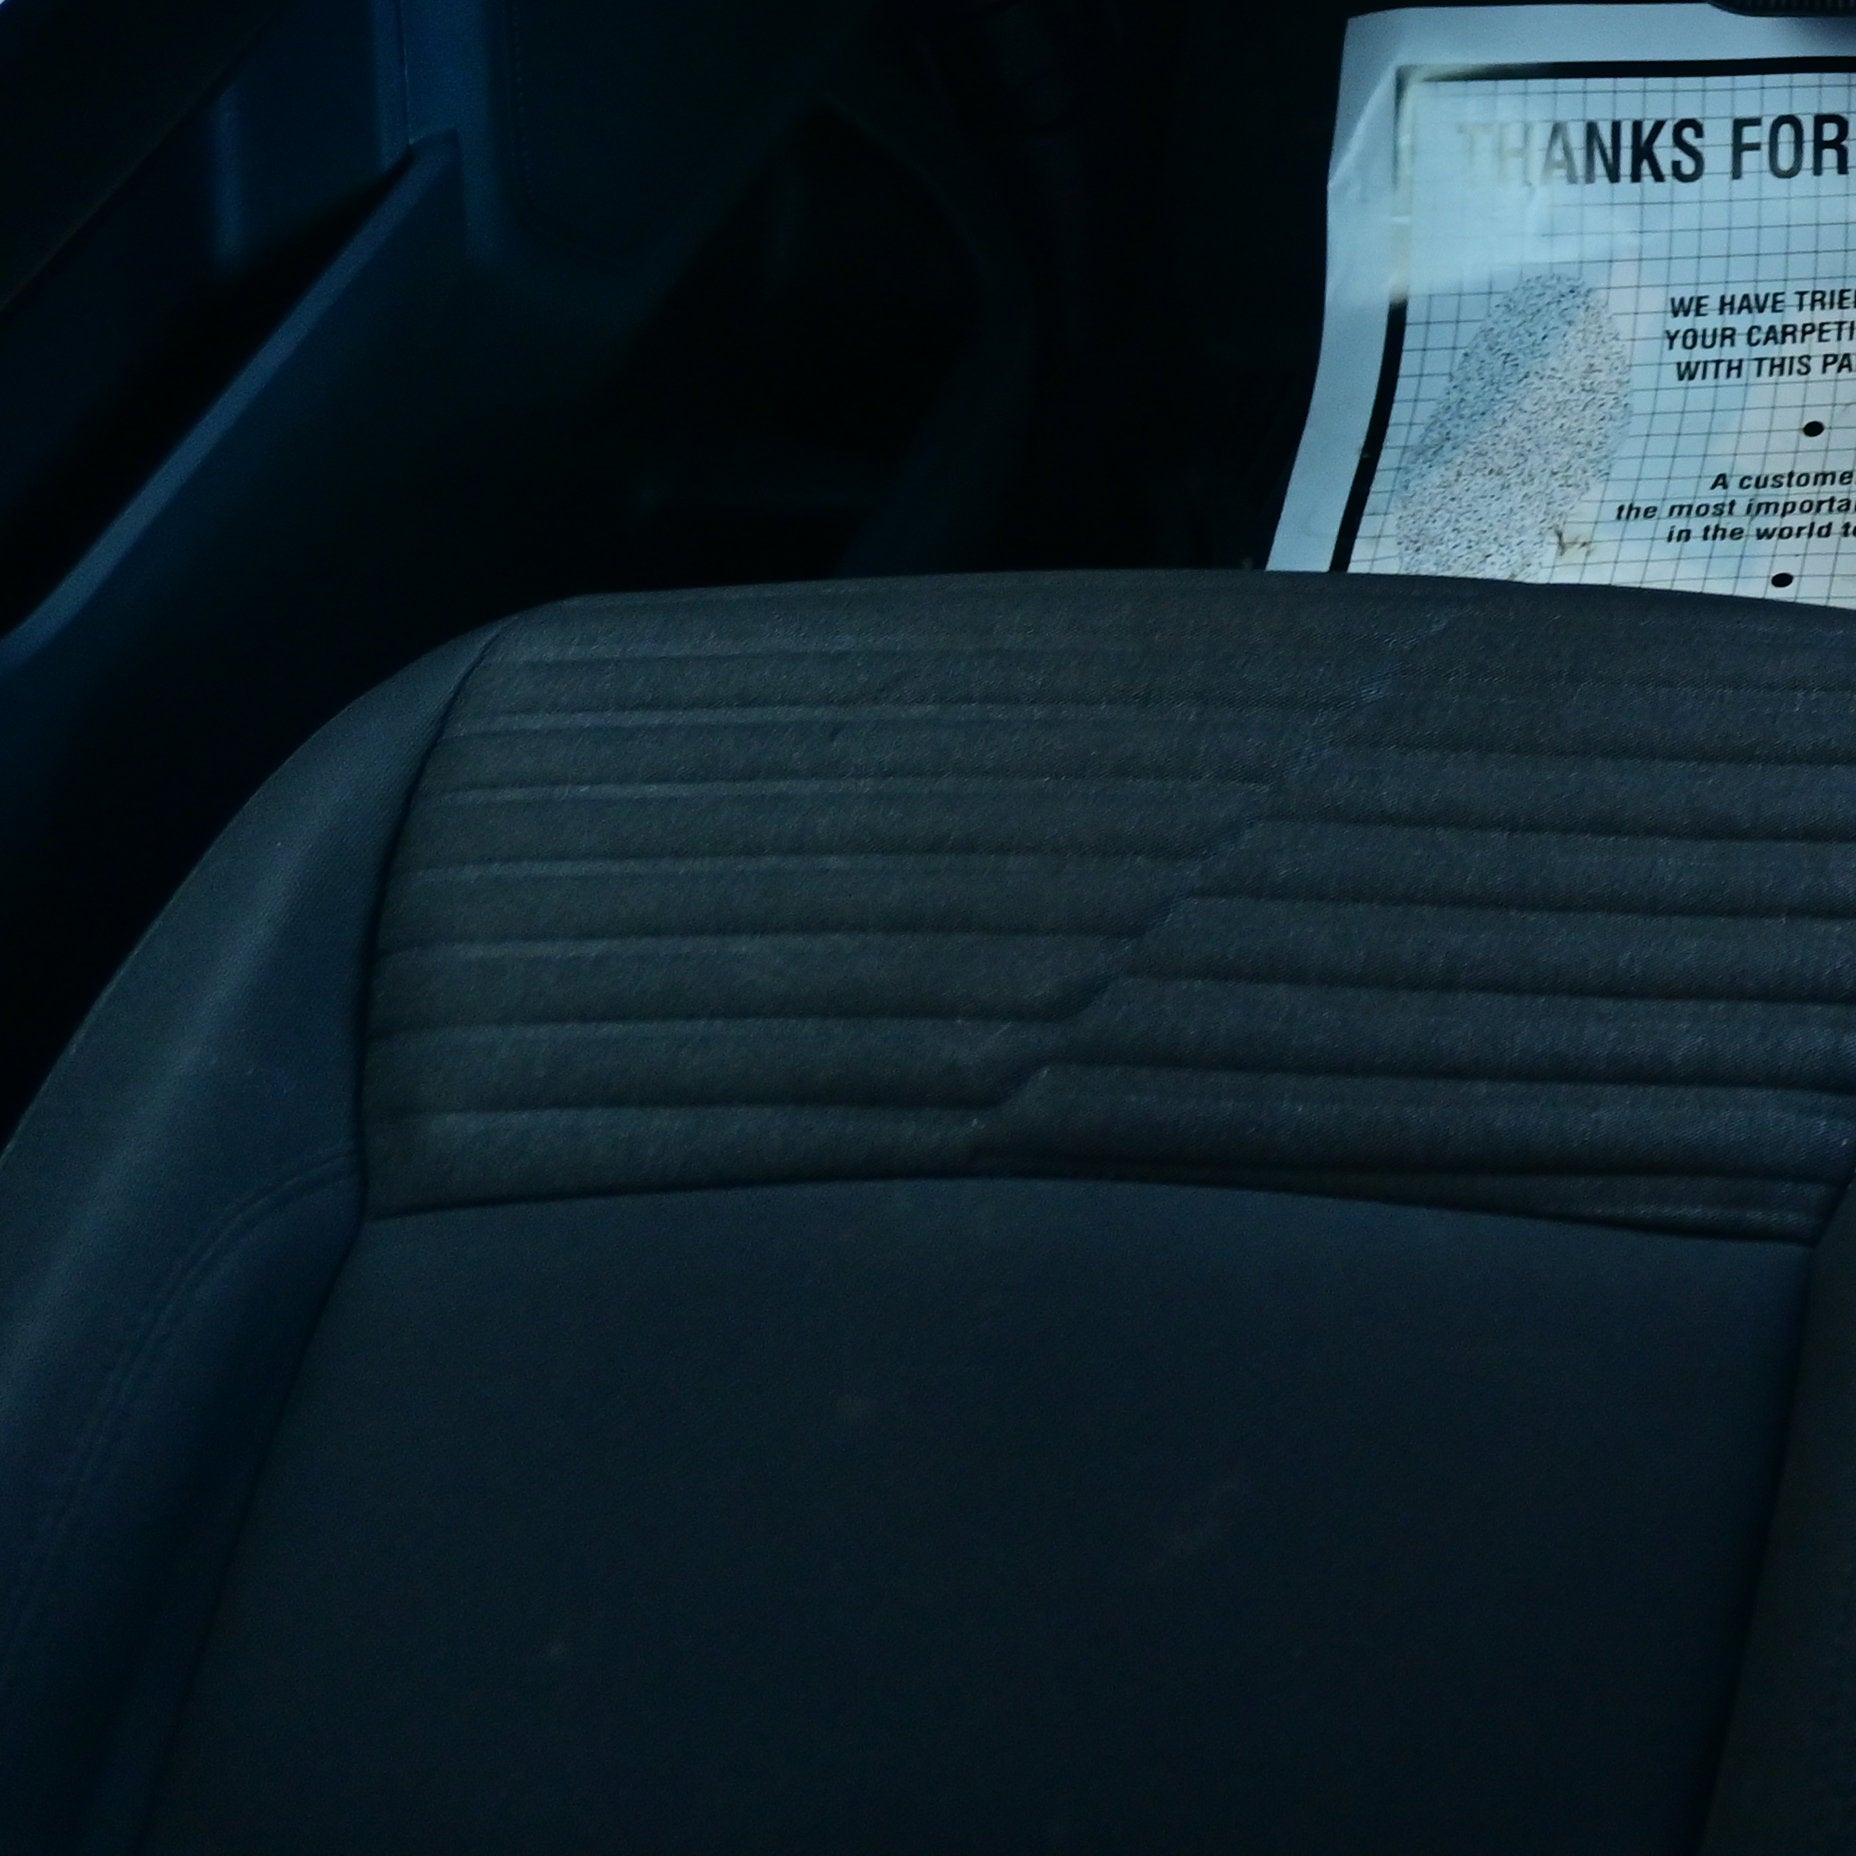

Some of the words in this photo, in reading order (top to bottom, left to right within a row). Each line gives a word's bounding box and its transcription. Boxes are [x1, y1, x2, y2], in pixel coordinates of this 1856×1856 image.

[1731, 112, 1849, 180] FOR
[1670, 295, 1709, 317] WE
[1720, 291, 1785, 315] HAVE
[1666, 327, 1736, 350] YOUR
[1676, 357, 1743, 381] WITH
[1755, 353, 1811, 378] THIS
[1710, 473, 1729, 490] A
[1617, 503, 1657, 520] the
[1669, 499, 1736, 518] most
[1667, 525, 1692, 543] in
[1703, 523, 1744, 542] the
[1756, 521, 1832, 541] world
